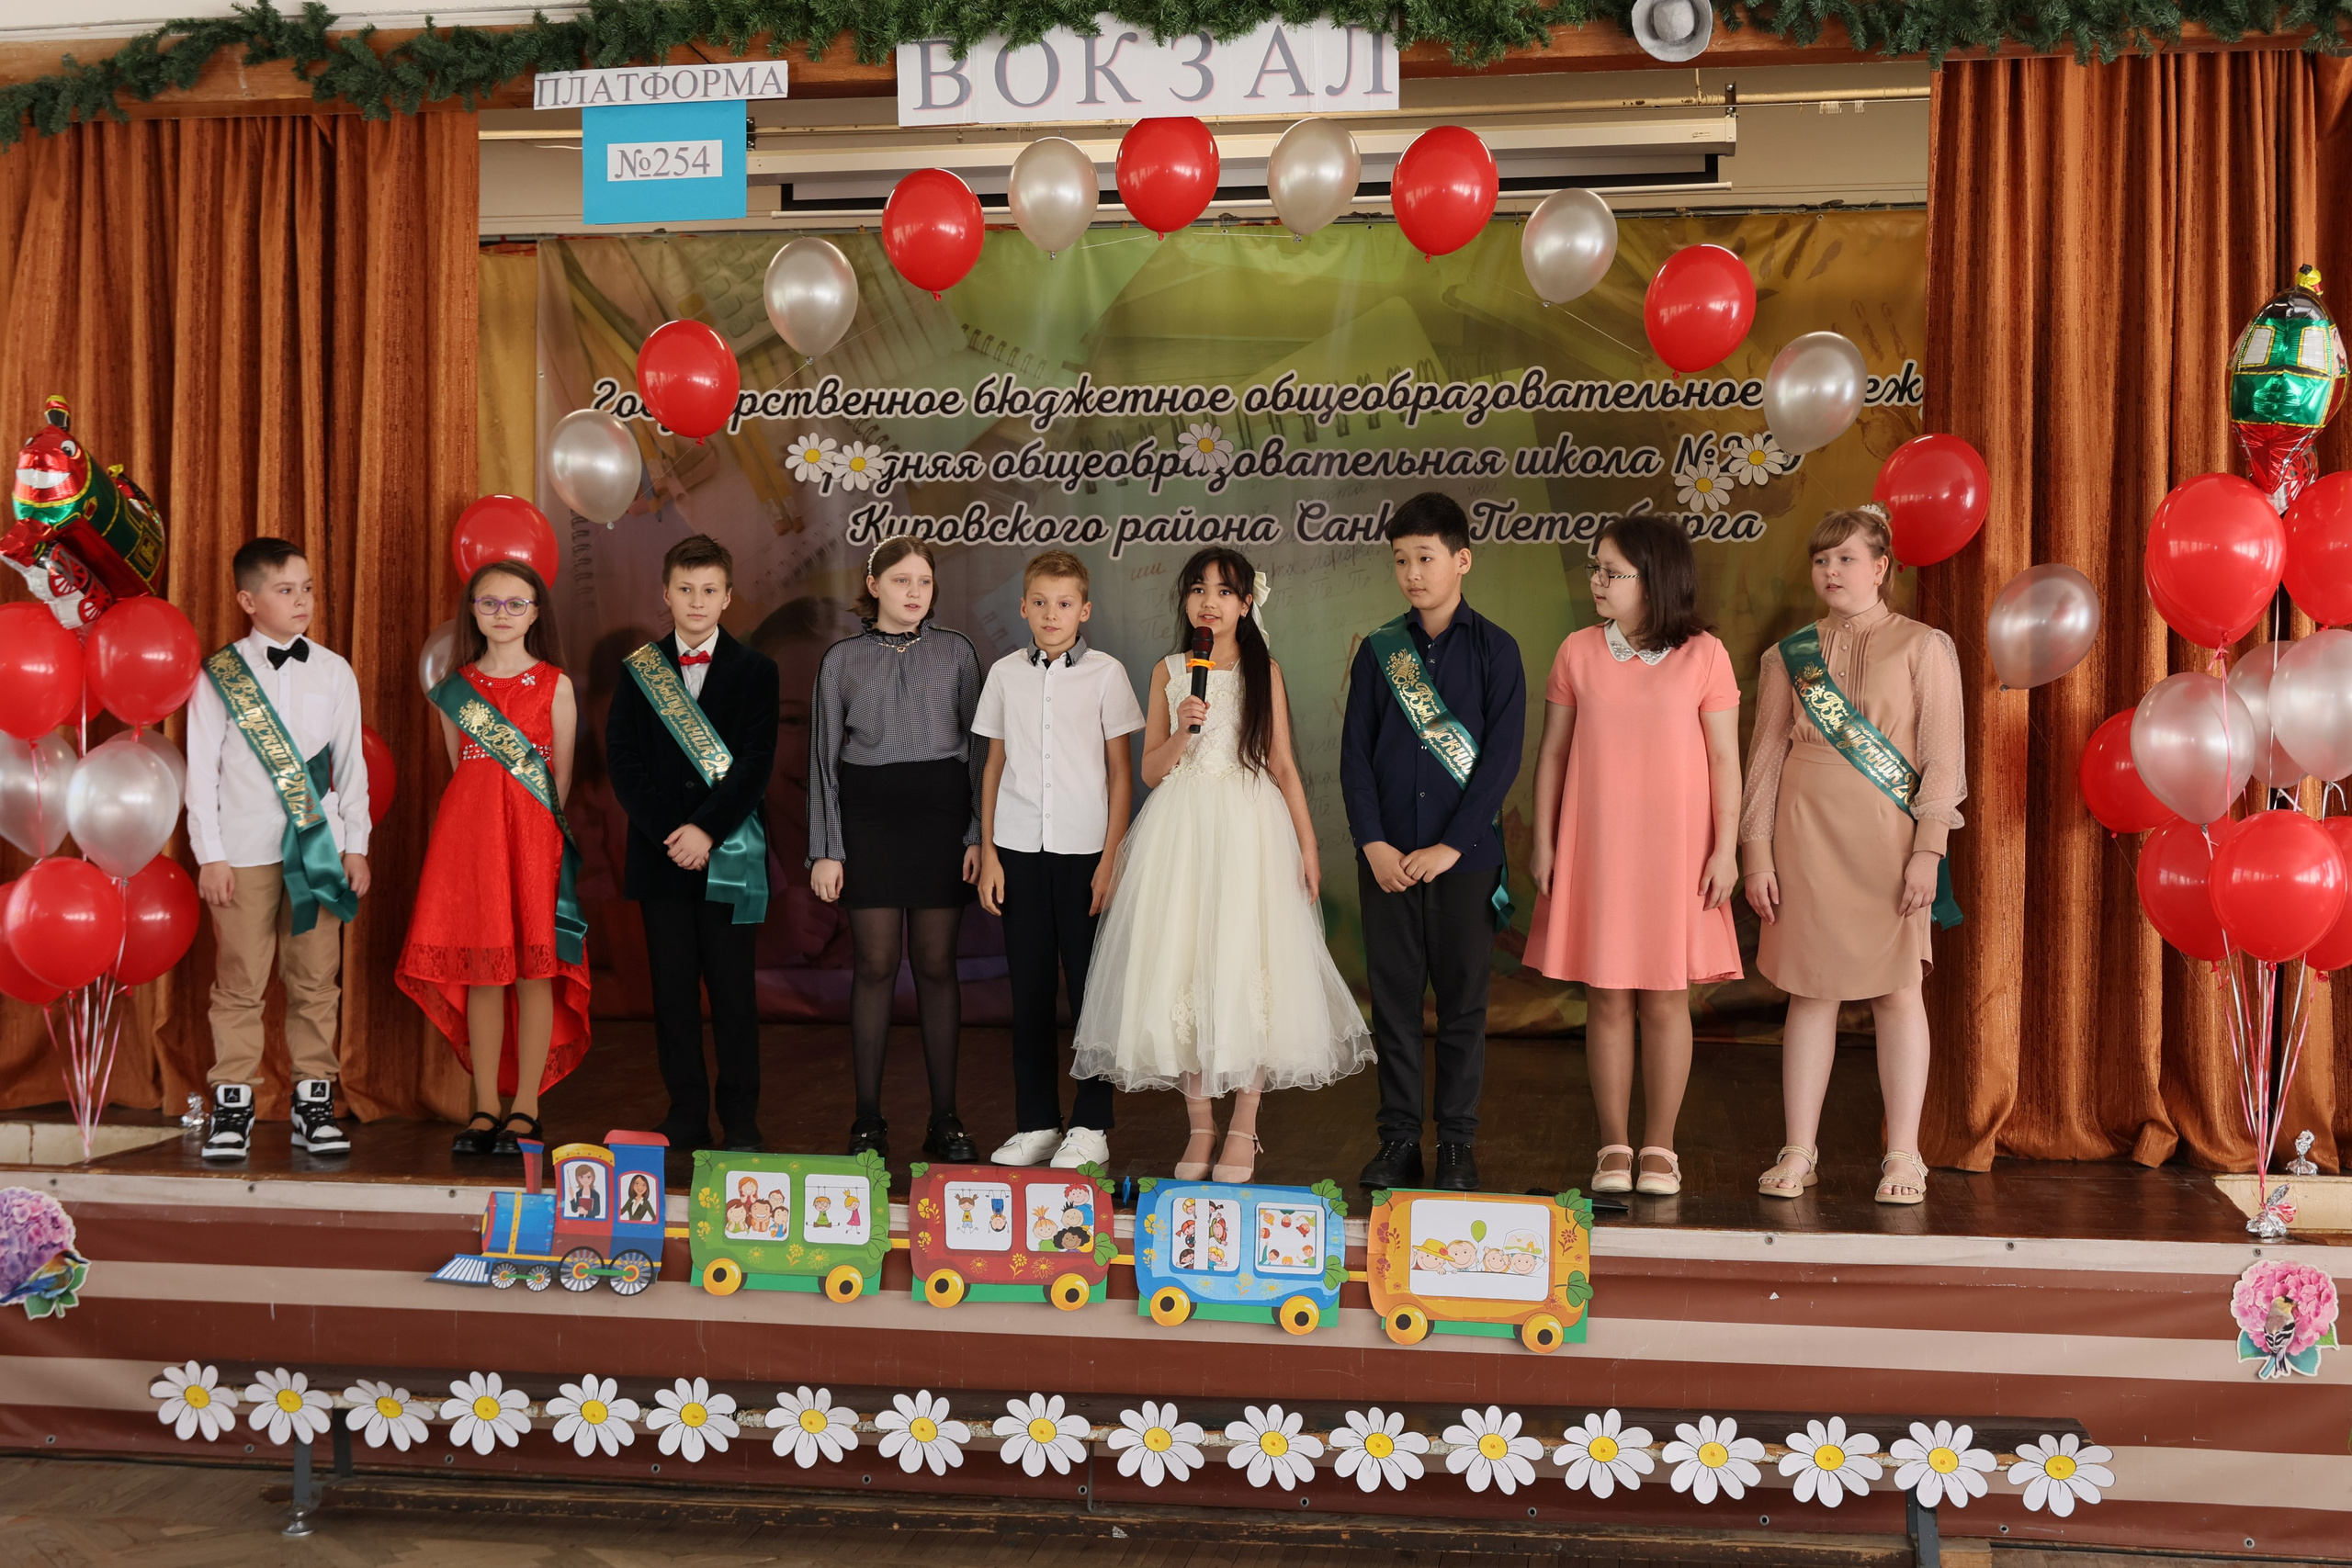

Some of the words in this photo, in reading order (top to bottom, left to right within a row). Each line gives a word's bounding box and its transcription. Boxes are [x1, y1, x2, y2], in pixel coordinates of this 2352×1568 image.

[536, 65, 786, 107] ПЛАТФОРМА
[912, 23, 1393, 110] ВОКЗАЛ
[615, 145, 710, 179] №254
[973, 375, 1232, 429] бюджетное
[1244, 368, 1763, 425] общеобразовательное
[1516, 434, 1661, 475] школа
[850, 503, 1106, 544] Кировского
[1112, 509, 1280, 557] района
[643, 666, 715, 758] Выпускник
[1811, 690, 1905, 784] Выпускник
[223, 672, 297, 782] Выпускник
[277, 771, 320, 828] 2024
